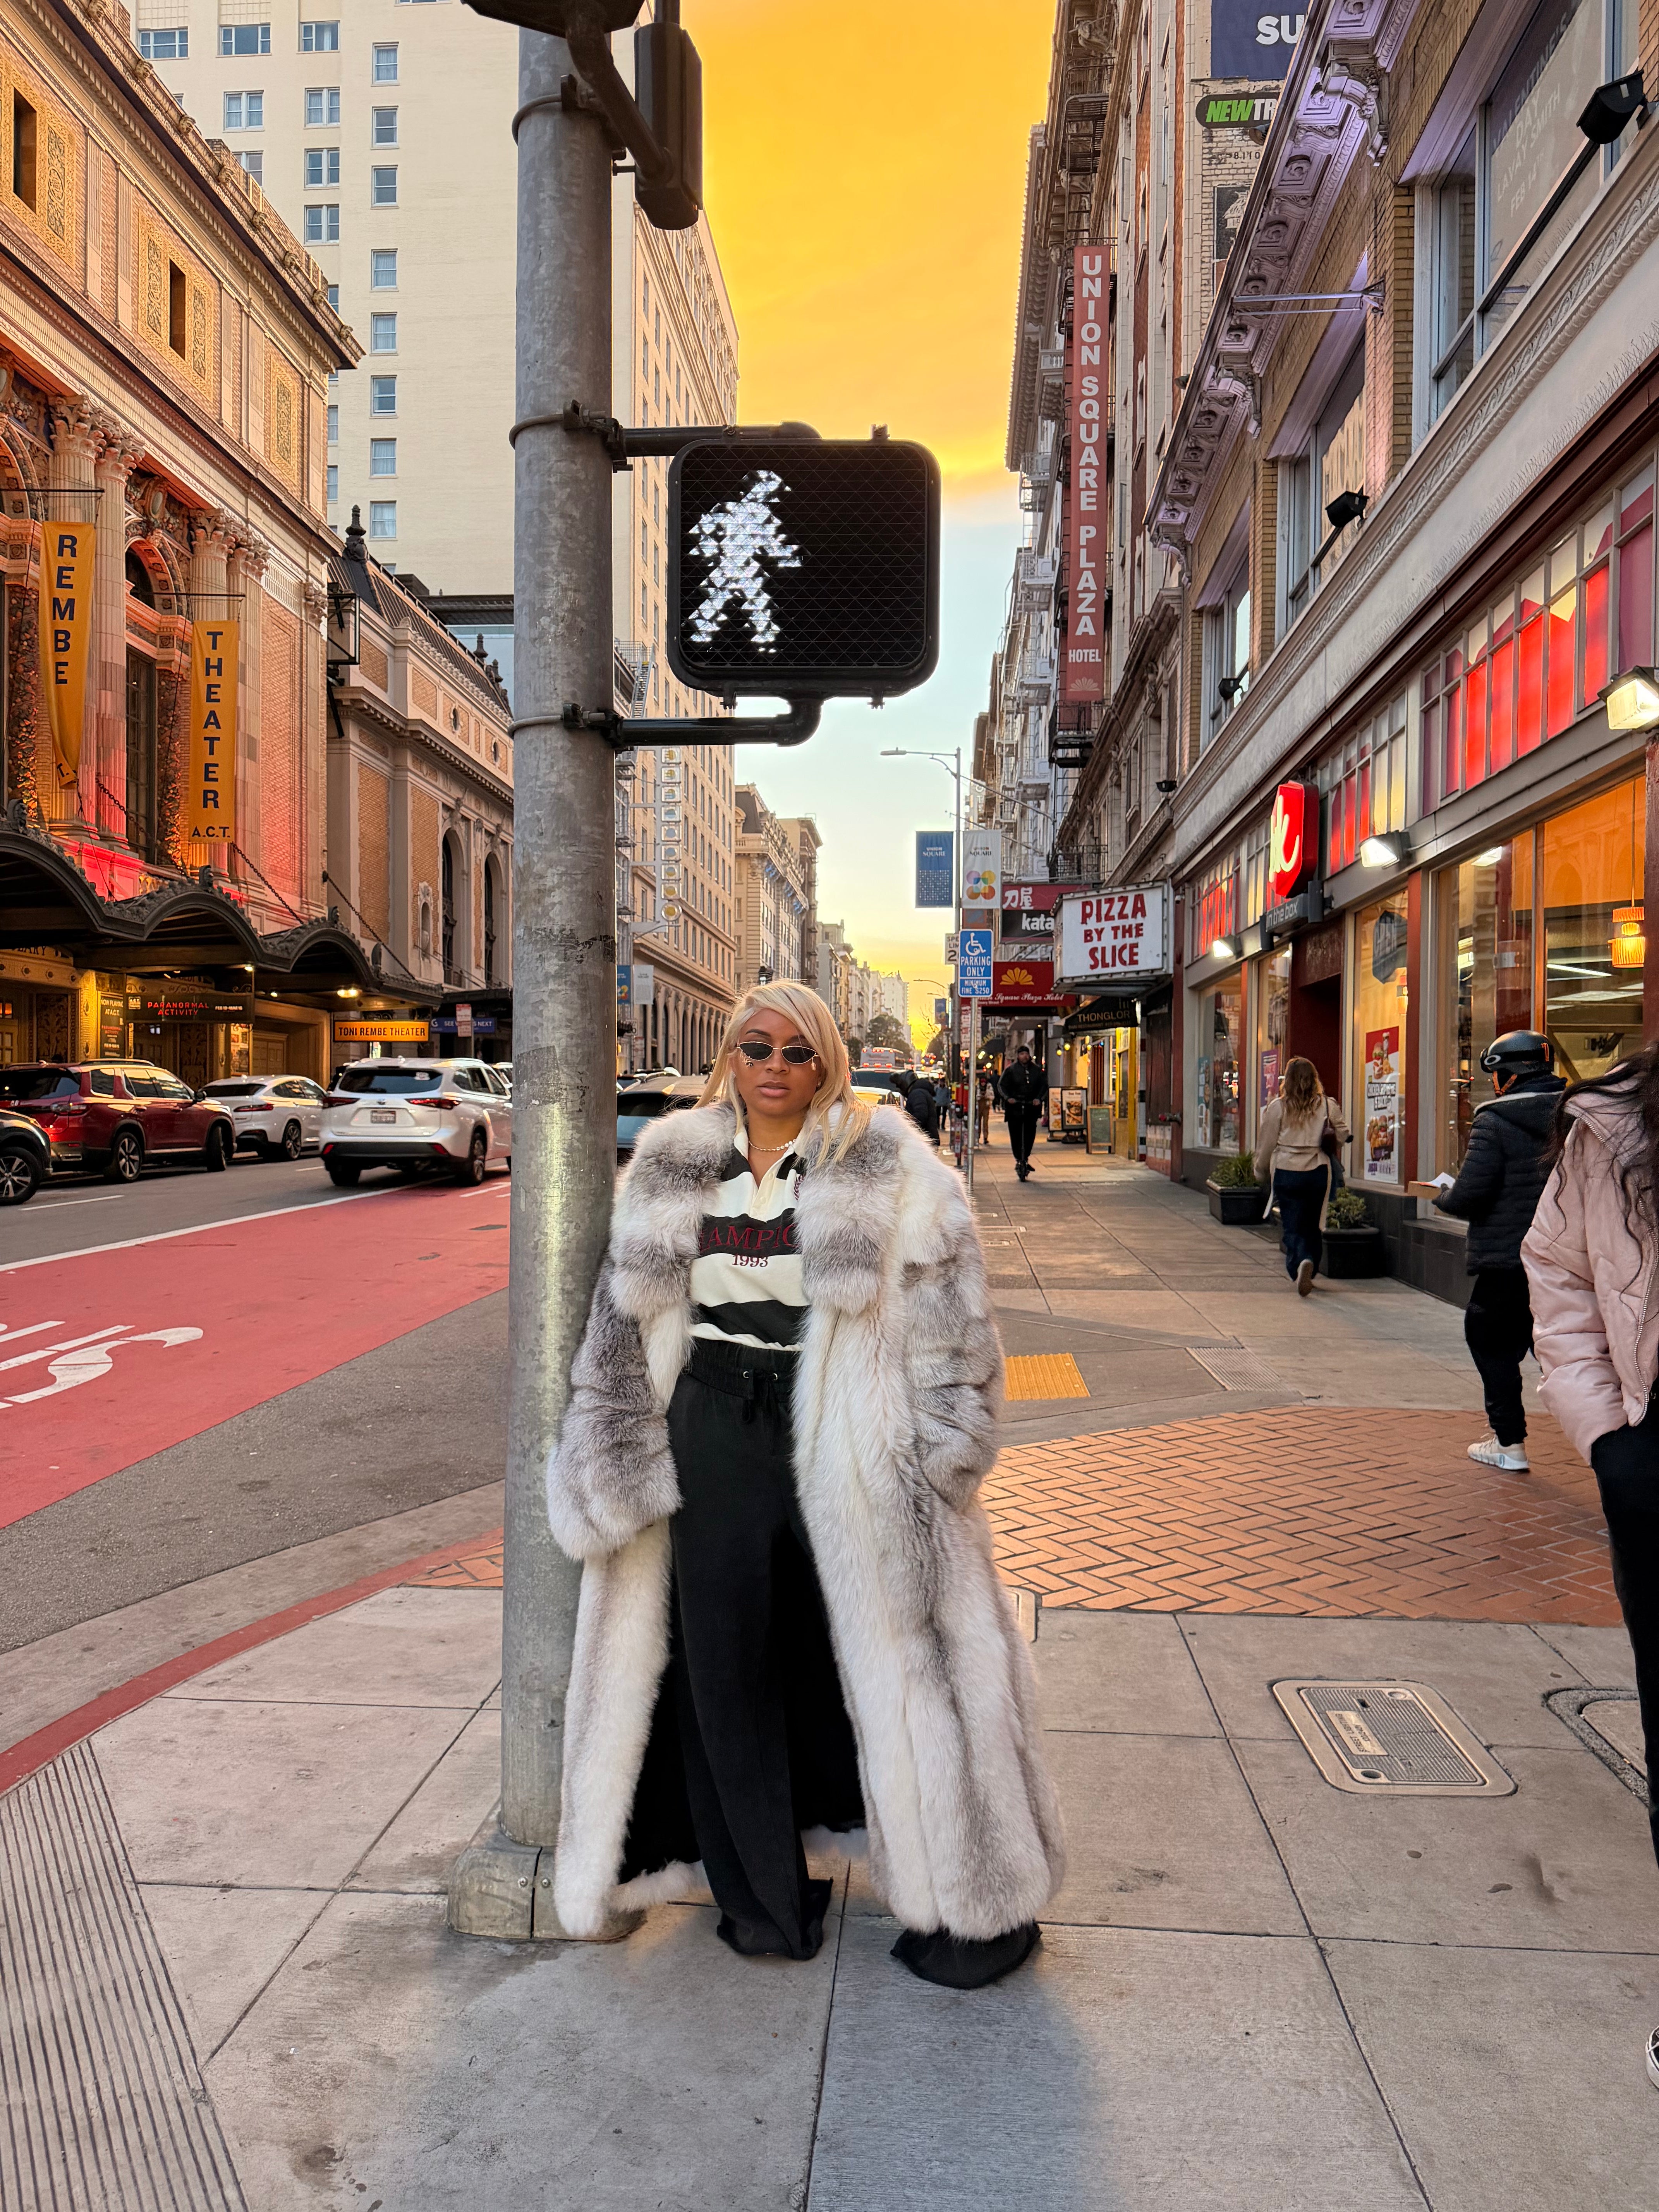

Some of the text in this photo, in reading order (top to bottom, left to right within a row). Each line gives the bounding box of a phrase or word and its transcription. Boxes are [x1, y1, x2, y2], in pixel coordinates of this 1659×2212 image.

[1255, 15, 1305, 45] SU
[1516, 86, 1540, 149] DAY
[1511, 180, 1525, 218] FEB
[1075, 255, 1102, 636] UNION SQUARE PLAZA
[52, 534, 77, 685] REMBE
[1068, 649, 1101, 663] HOTEL
[203, 631, 223, 809] THEATER
[192, 826, 230, 838] A.C.T.
[1002, 887, 1034, 910] 刀屋
[1080, 893, 1147, 925] PIZZA
[1266, 895, 1298, 928] in the box
[1084, 923, 1144, 943] BY THE
[960, 956, 991, 966] PARKING
[1088, 943, 1139, 970] SLICE
[967, 967, 985, 977] ONLY
[994, 992, 1020, 1004] Square
[1021, 993, 1042, 1004] Plaza
[1043, 993, 1065, 1001] Hotel
[1077, 1010, 1130, 1023] THONGLOR
[338, 1027, 357, 1036] TONI
[360, 1027, 387, 1036] REMBE
[390, 1027, 425, 1036] THEATER
[731, 1253, 768, 1267] 1993
